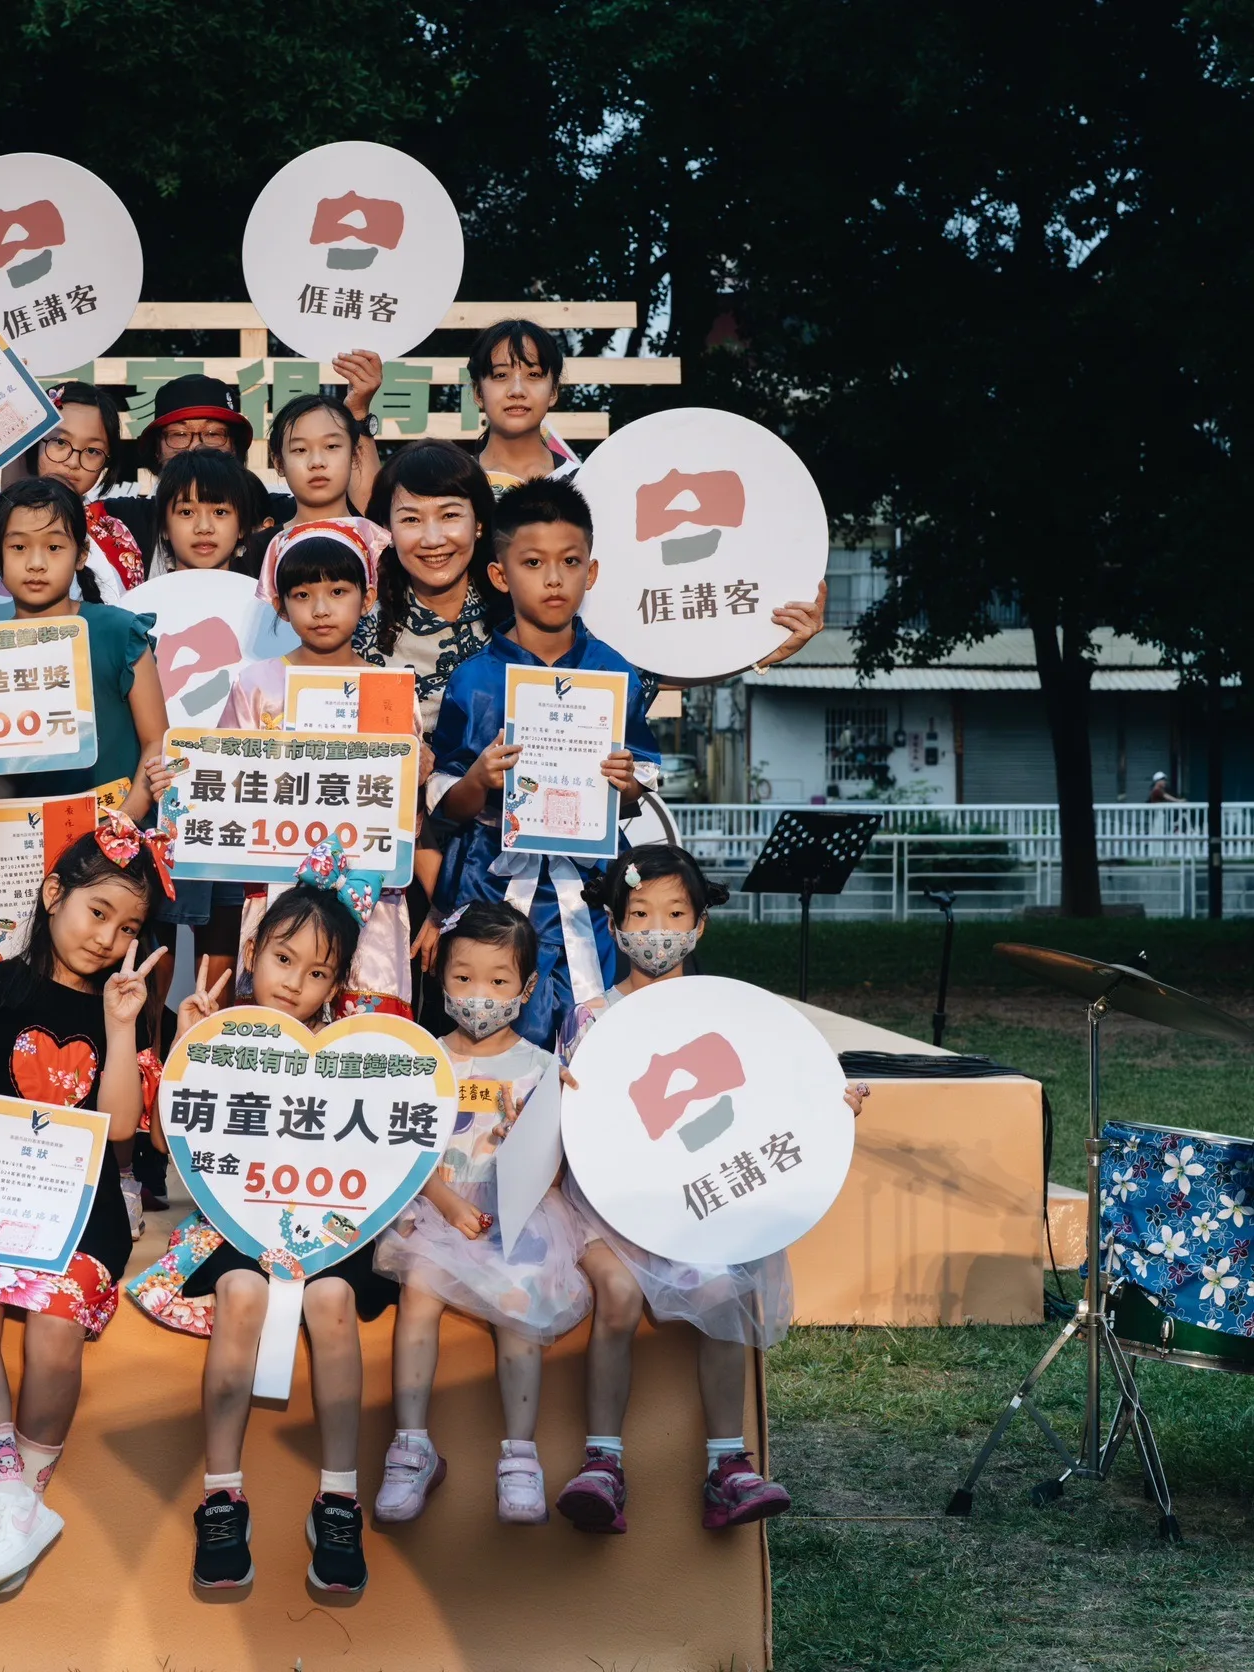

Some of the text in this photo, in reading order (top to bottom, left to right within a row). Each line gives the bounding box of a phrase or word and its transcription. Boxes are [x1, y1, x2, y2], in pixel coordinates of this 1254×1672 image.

[549, 711, 574, 723] 獎狀
[189, 769, 394, 809] 最佳創意獎
[222, 1021, 282, 1038] 2024
[187, 1043, 438, 1078] 客家很有市 萌童變裝秀
[170, 1088, 439, 1148] 萌童迷人獎
[20, 1145, 49, 1160] 獎狀
